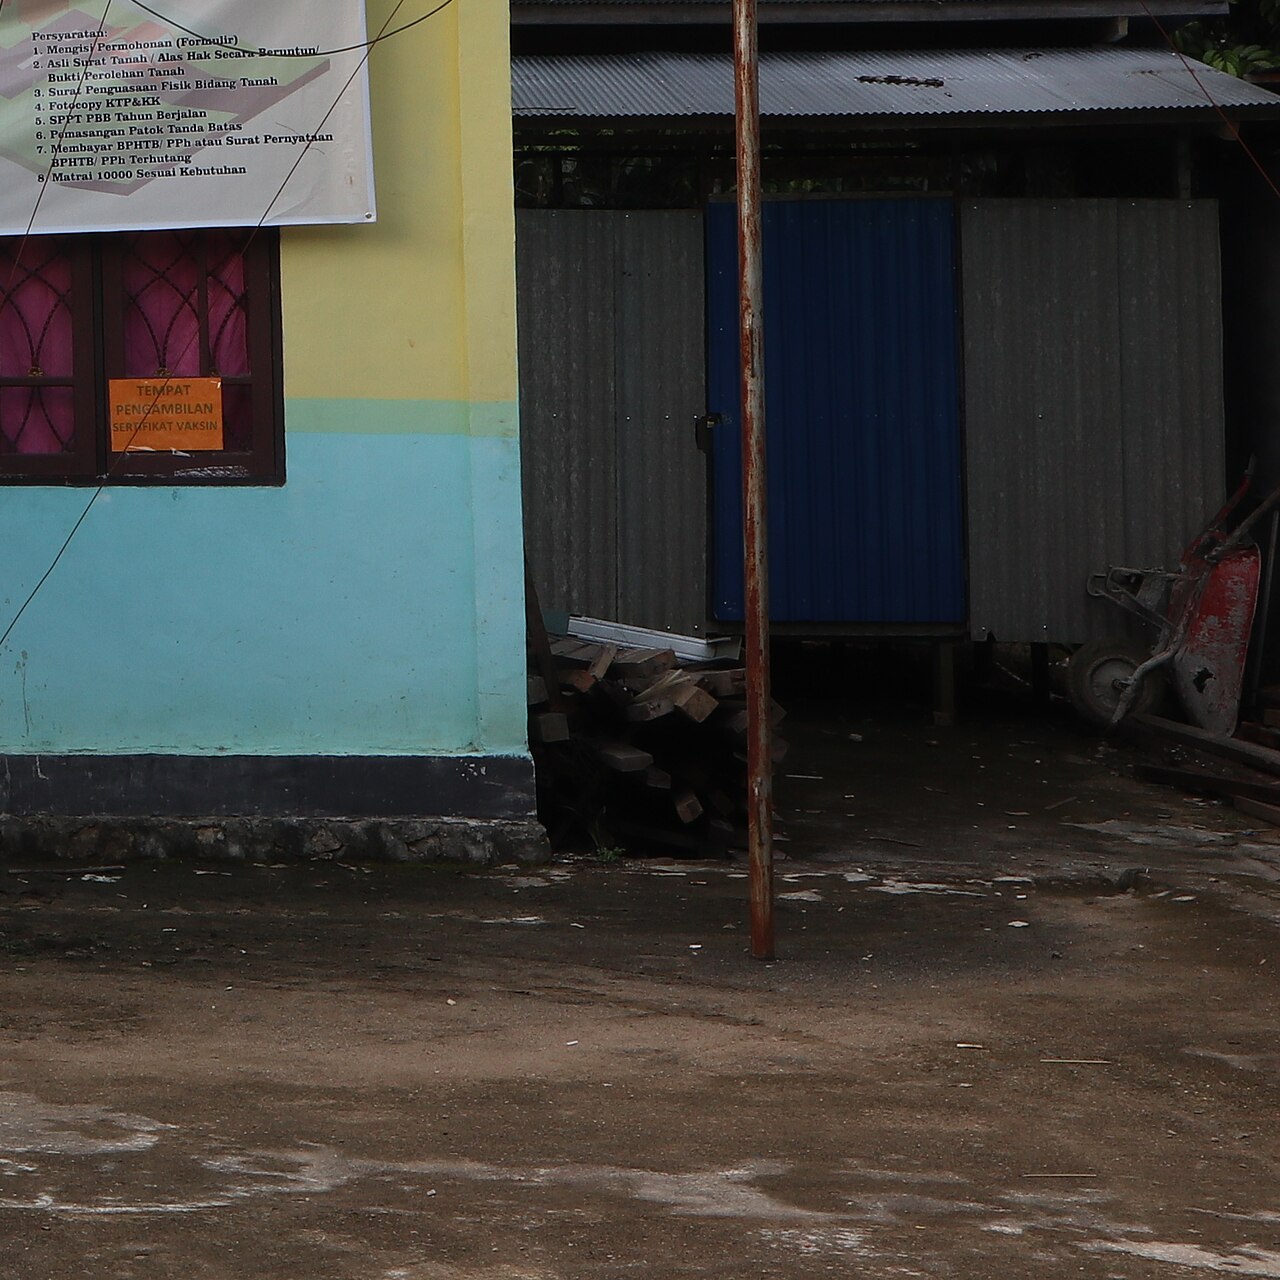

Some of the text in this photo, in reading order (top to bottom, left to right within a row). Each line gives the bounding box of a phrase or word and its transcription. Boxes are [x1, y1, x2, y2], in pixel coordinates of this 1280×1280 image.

[32, 30, 108, 41] Persyaratan:
[33, 35, 238, 55] 1. Mengisi Permohonan (Formulir)
[33, 61, 43, 69] 2.
[47, 58, 69, 68] Asli
[73, 57, 107, 67] Surat
[110, 54, 147, 65] Tanah
[158, 52, 183, 62] Alas
[187, 51, 211, 61] Hak
[215, 49, 255, 59] Secara
[48, 67, 185, 83] Bukti Perolehan Tanah
[34, 76, 278, 97] 3. Surat Penguasaan Fisik Bidang Tanah
[49, 100, 102, 112] Fotocopy
[105, 97, 161, 108] KTP&KK
[35, 109, 207, 125] 5. SPPT PBB Tahun Berjalan
[36, 121, 242, 140] 6. Pemasangan Patok Tanda Batas
[36, 145, 47, 154] 7.
[51, 142, 114, 154] Membayar
[167, 138, 191, 149] PPh
[195, 139, 222, 148] atau
[225, 135, 260, 146] Surat
[263, 133, 334, 145] Pernyataan
[101, 155, 125, 166] PPh
[129, 153, 192, 165] Terhutang
[52, 171, 93, 182] Matrai
[97, 170, 133, 181] 10000
[136, 167, 176, 179] Sesuai
[180, 164, 247, 177] Kebutuhan
[136, 385, 191, 396] TEMPAT
[116, 403, 213, 415] PENGAMBILAN
[176, 421, 218, 431] VAKSIN
